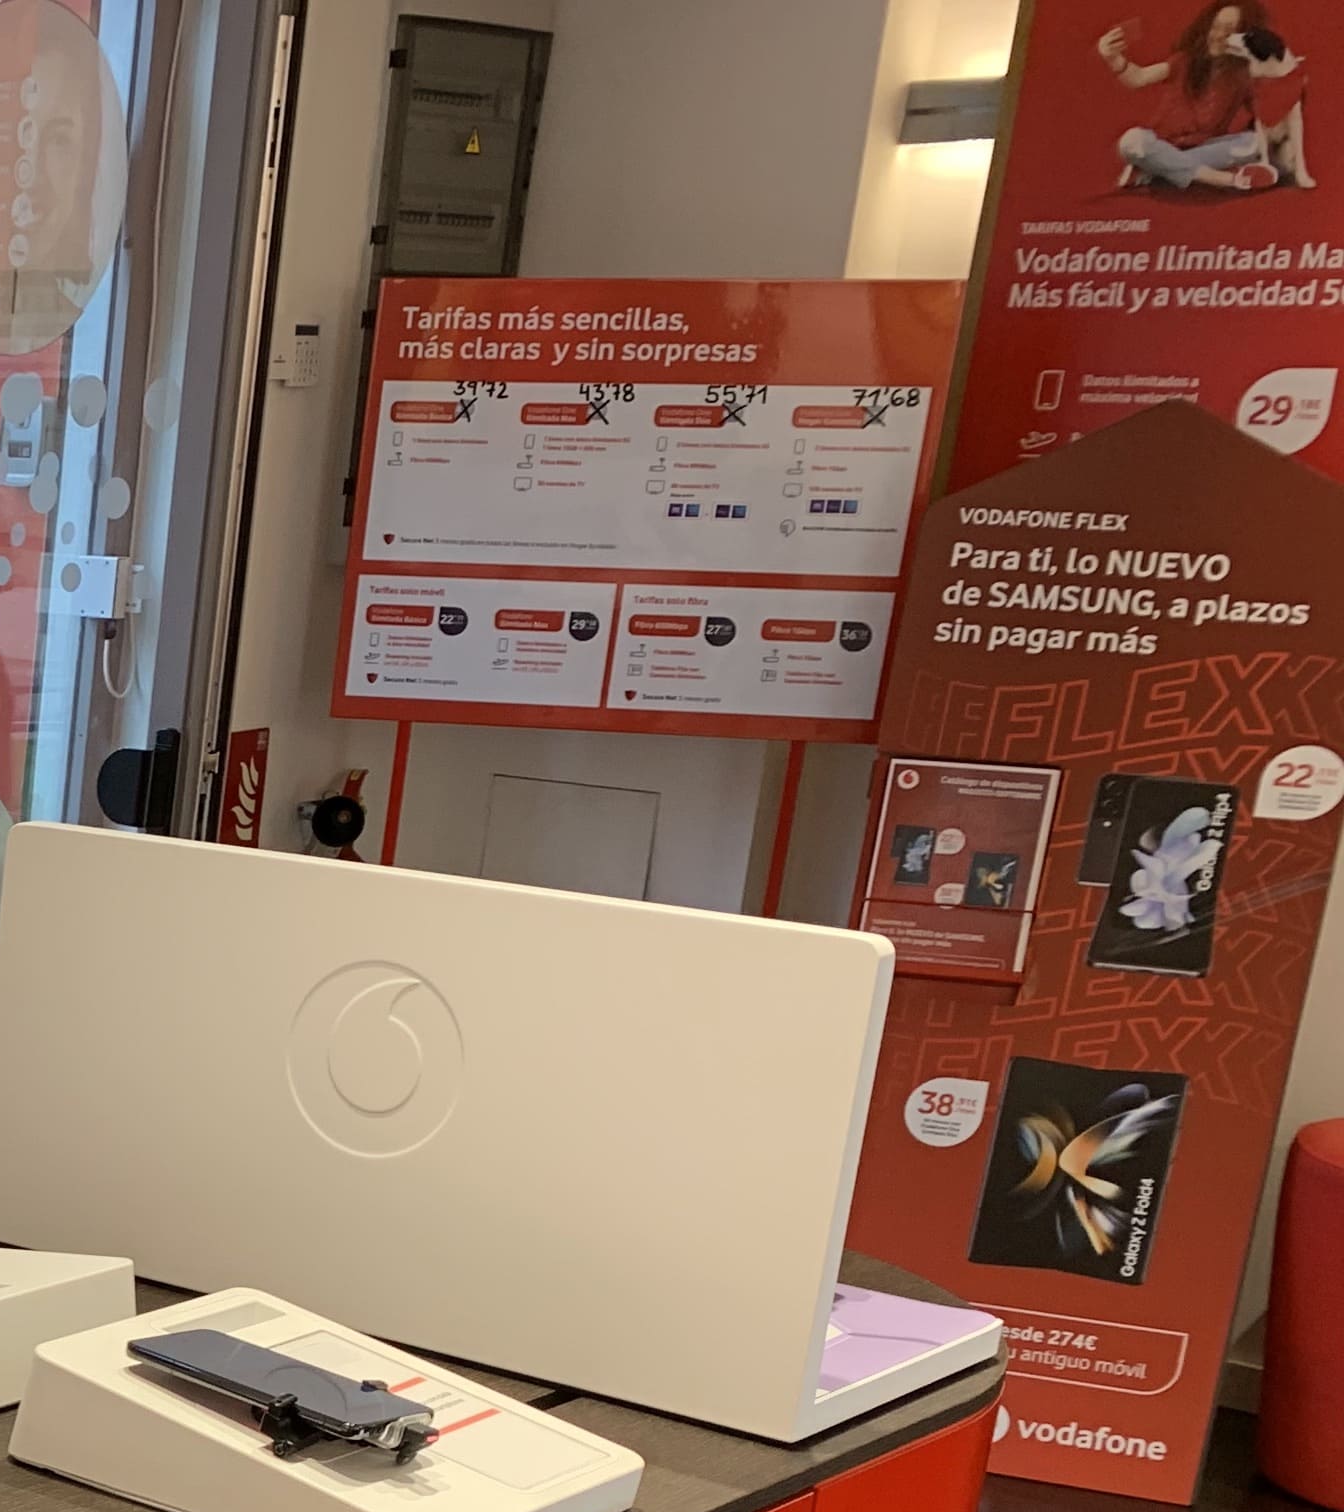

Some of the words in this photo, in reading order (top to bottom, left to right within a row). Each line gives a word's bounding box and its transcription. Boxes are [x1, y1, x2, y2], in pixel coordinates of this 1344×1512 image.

[1021, 221, 1073, 235] TARIFAS
[1075, 219, 1151, 234] VODAFONE
[1015, 246, 1150, 274] Vodafone
[1156, 243, 1292, 272] Ilimitada
[1007, 279, 1064, 308] Más
[1067, 279, 1127, 308] fácil
[1126, 286, 1153, 314] y
[1151, 288, 1170, 308] a
[1175, 279, 1319, 307] velocidad
[402, 305, 493, 332] Tarifas
[497, 305, 555, 332] más
[561, 307, 690, 335] sencillas,
[398, 334, 455, 361] más
[460, 336, 542, 361] claras
[550, 342, 571, 367] y
[574, 338, 616, 361] sin
[621, 342, 758, 368] sorpresas
[578, 383, 636, 402] 43'78
[1247, 394, 1294, 427] 29
[959, 507, 1073, 529] VODAFONE
[1075, 512, 1130, 532] FLEX
[949, 541, 1022, 572] Para
[1027, 543, 1058, 576] ti,
[1065, 546, 1100, 575] lo
[1105, 549, 1232, 582] NUEVO
[941, 579, 983, 607] de
[987, 580, 1162, 620] SAMSUNG,
[1167, 598, 1189, 620] a
[1193, 593, 1312, 627] plazos
[933, 617, 982, 644] sin
[986, 621, 1083, 656] pagar
[1084, 625, 1159, 655] más
[1273, 762, 1314, 789] 22
[1210, 792, 1233, 827] Flip4
[917, 1090, 955, 1116] 38
[1133, 1178, 1156, 1216] Fold4
[1130, 1217, 1147, 1227] Z
[1119, 1226, 1148, 1277] Galaxy
[1047, 1330, 1099, 1351] 274€
[1019, 1348, 1091, 1371] antiguo
[1094, 1360, 1148, 1380] móvil
[1017, 1419, 1168, 1461] vodafone
